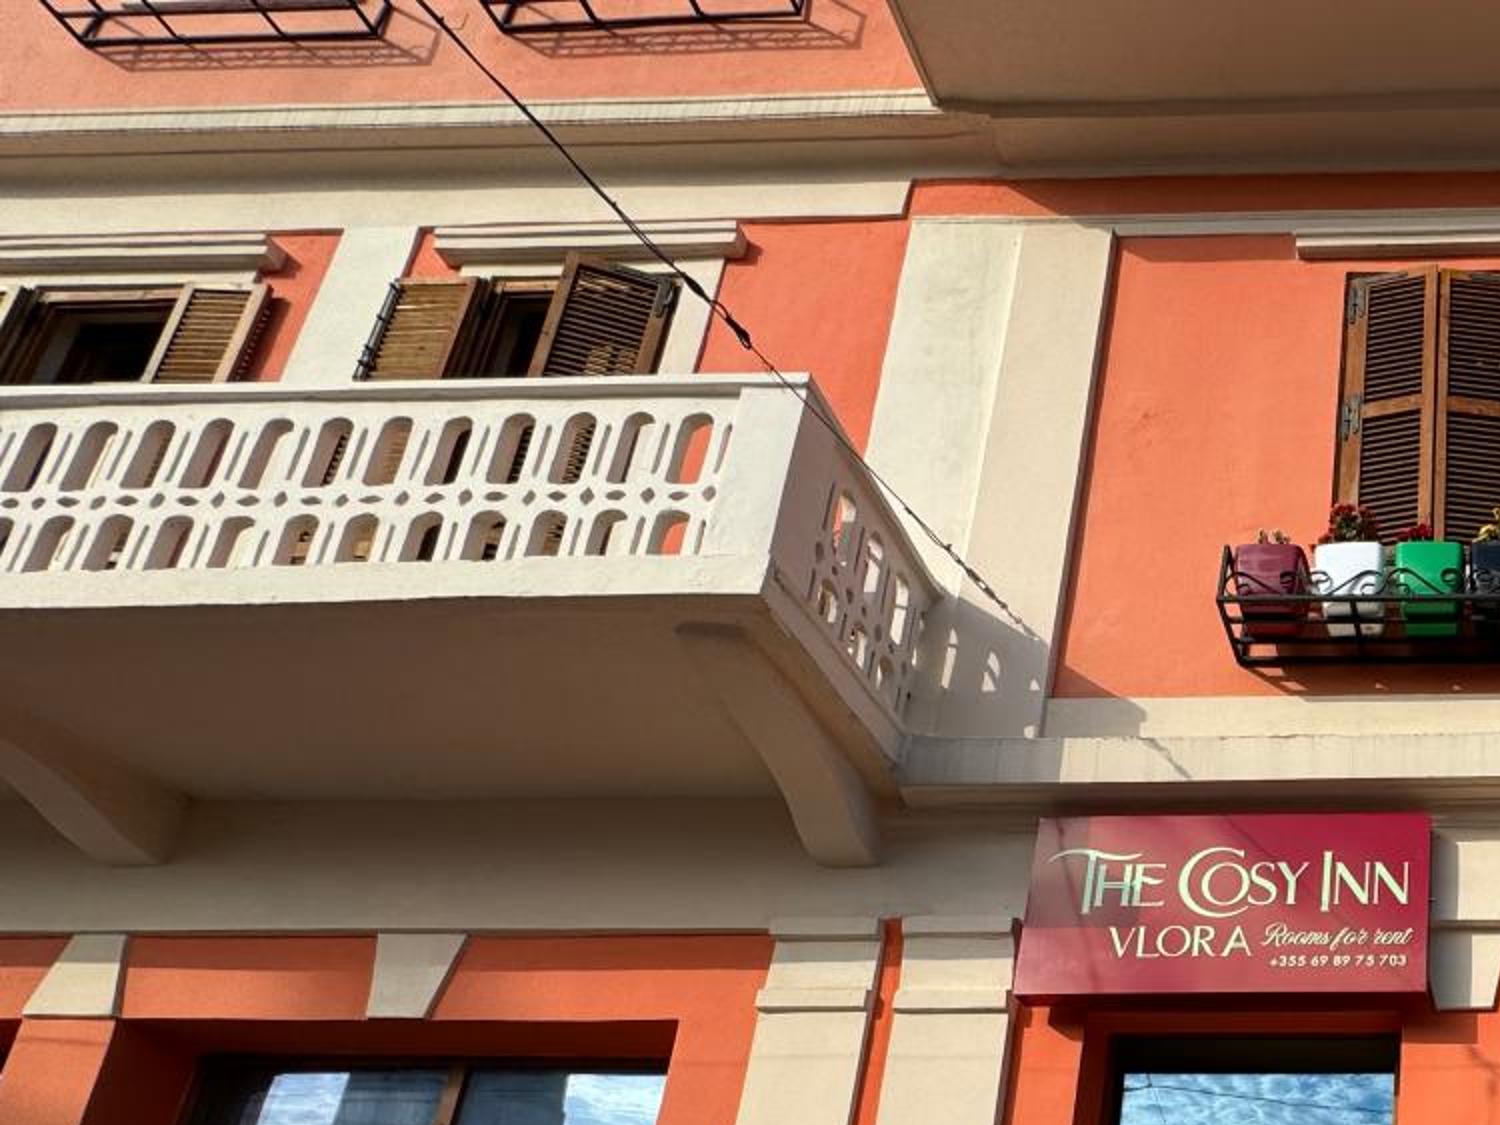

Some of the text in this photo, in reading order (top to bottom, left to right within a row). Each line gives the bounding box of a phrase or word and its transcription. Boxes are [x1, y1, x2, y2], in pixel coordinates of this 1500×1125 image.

[1048, 846, 1410, 918] THE COSY INN
[1109, 925, 1252, 958] VLORA
[1261, 922, 1413, 951] Rooms for rent
[1269, 955, 1408, 967] +355 69 89 75 703
